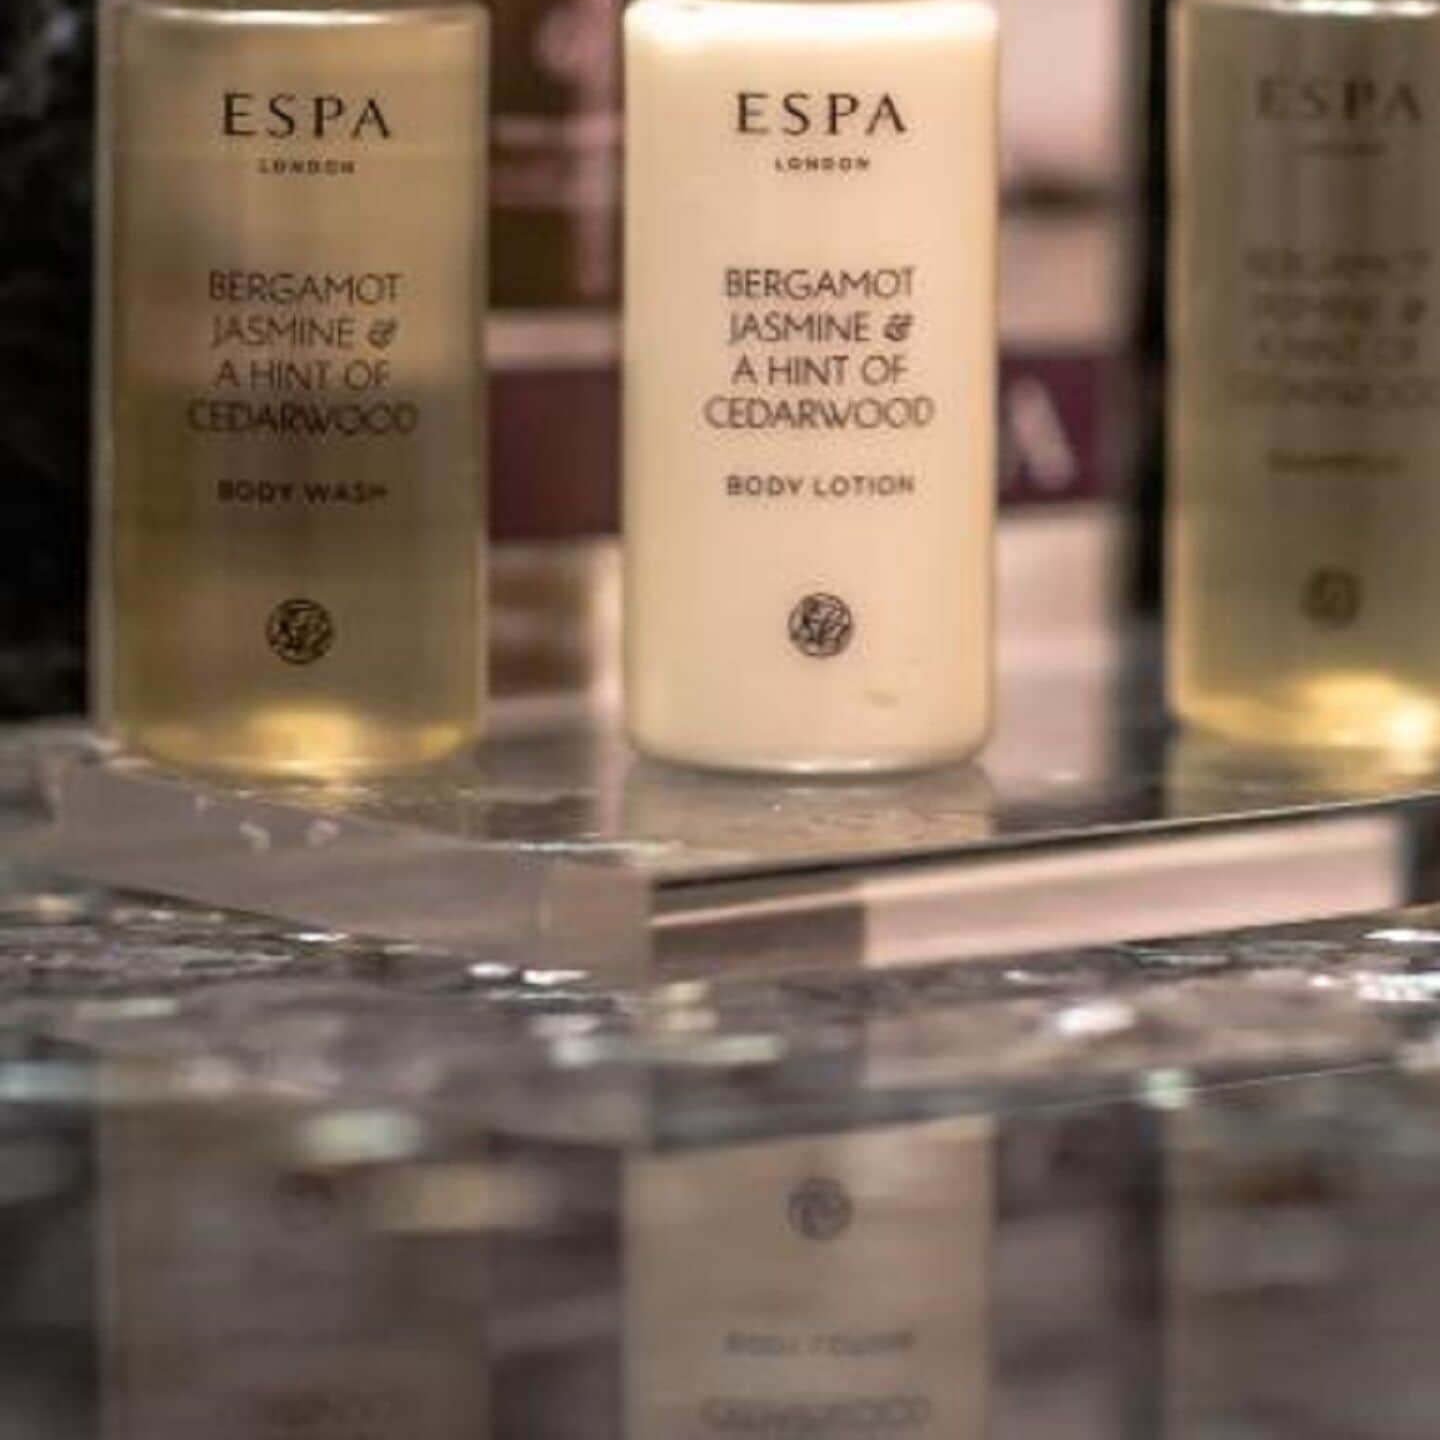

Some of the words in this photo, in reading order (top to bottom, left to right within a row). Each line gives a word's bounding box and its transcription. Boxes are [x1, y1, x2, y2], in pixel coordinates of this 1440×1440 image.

[735, 90, 908, 137] ESPA
[1256, 72, 1424, 124] ESPA
[222, 91, 392, 140] ESPA
[257, 157, 357, 177] LONDON
[773, 154, 872, 174] LONDON
[207, 268, 403, 306] BERGAMOT
[724, 266, 915, 301] BERGAMOT
[211, 317, 355, 349] JASMINE
[367, 318, 399, 350] &
[728, 311, 870, 345] JASMINE
[882, 313, 914, 344] &
[215, 359, 241, 391] A
[250, 360, 329, 393] HINT
[343, 360, 390, 393] OF
[731, 355, 758, 386] A
[767, 355, 851, 387] HINT
[860, 355, 910, 387] OF
[188, 400, 419, 437] CEDARWOOD
[703, 396, 936, 431] CEDARWOOD
[216, 479, 297, 505] BODY
[303, 480, 390, 506] WASH
[725, 474, 804, 498] BODY
[812, 474, 916, 498] LOTION
